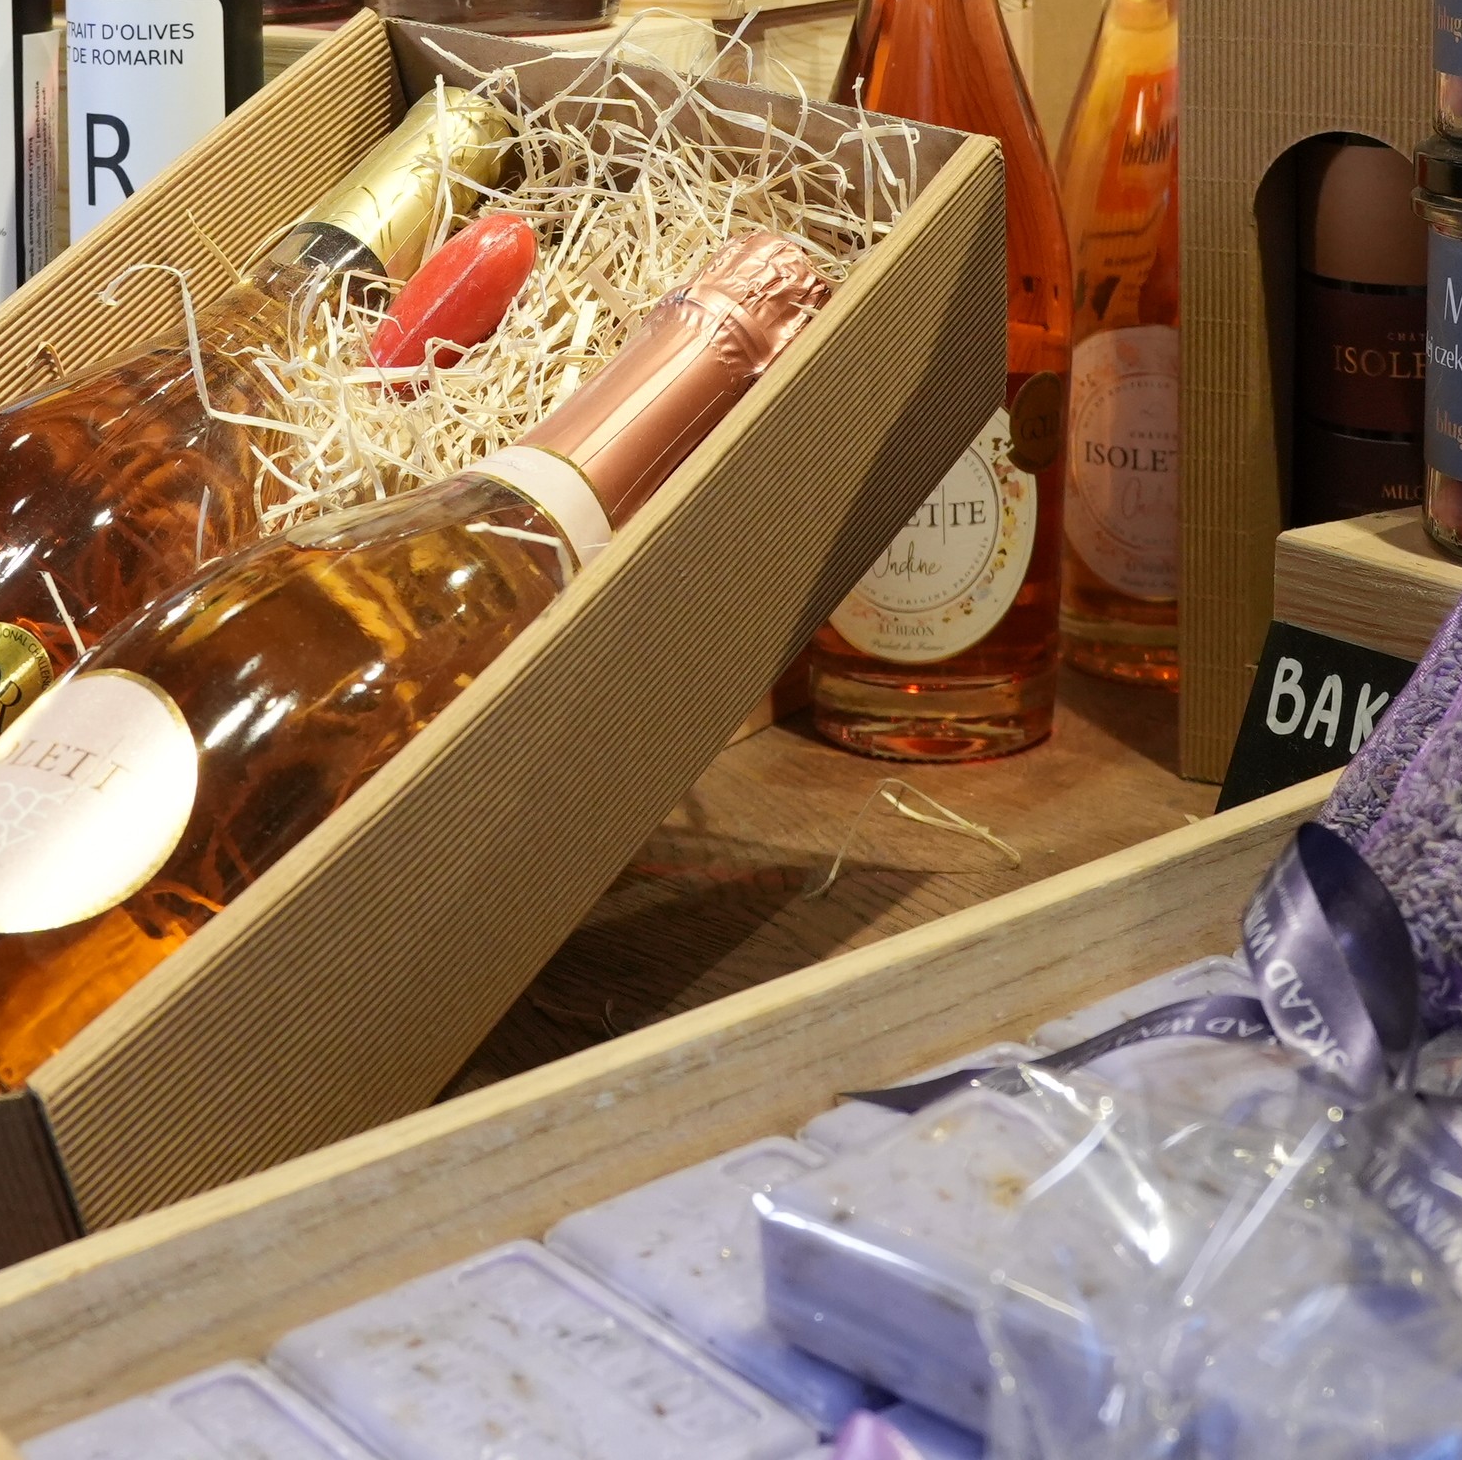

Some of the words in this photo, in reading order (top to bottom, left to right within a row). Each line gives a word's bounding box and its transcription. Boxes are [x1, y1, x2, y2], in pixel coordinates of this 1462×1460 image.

[101, 22, 195, 41] D'OLIVES
[72, 46, 87, 64] DE
[92, 48, 184, 66] ROMARIN
[86, 112, 135, 207] R
